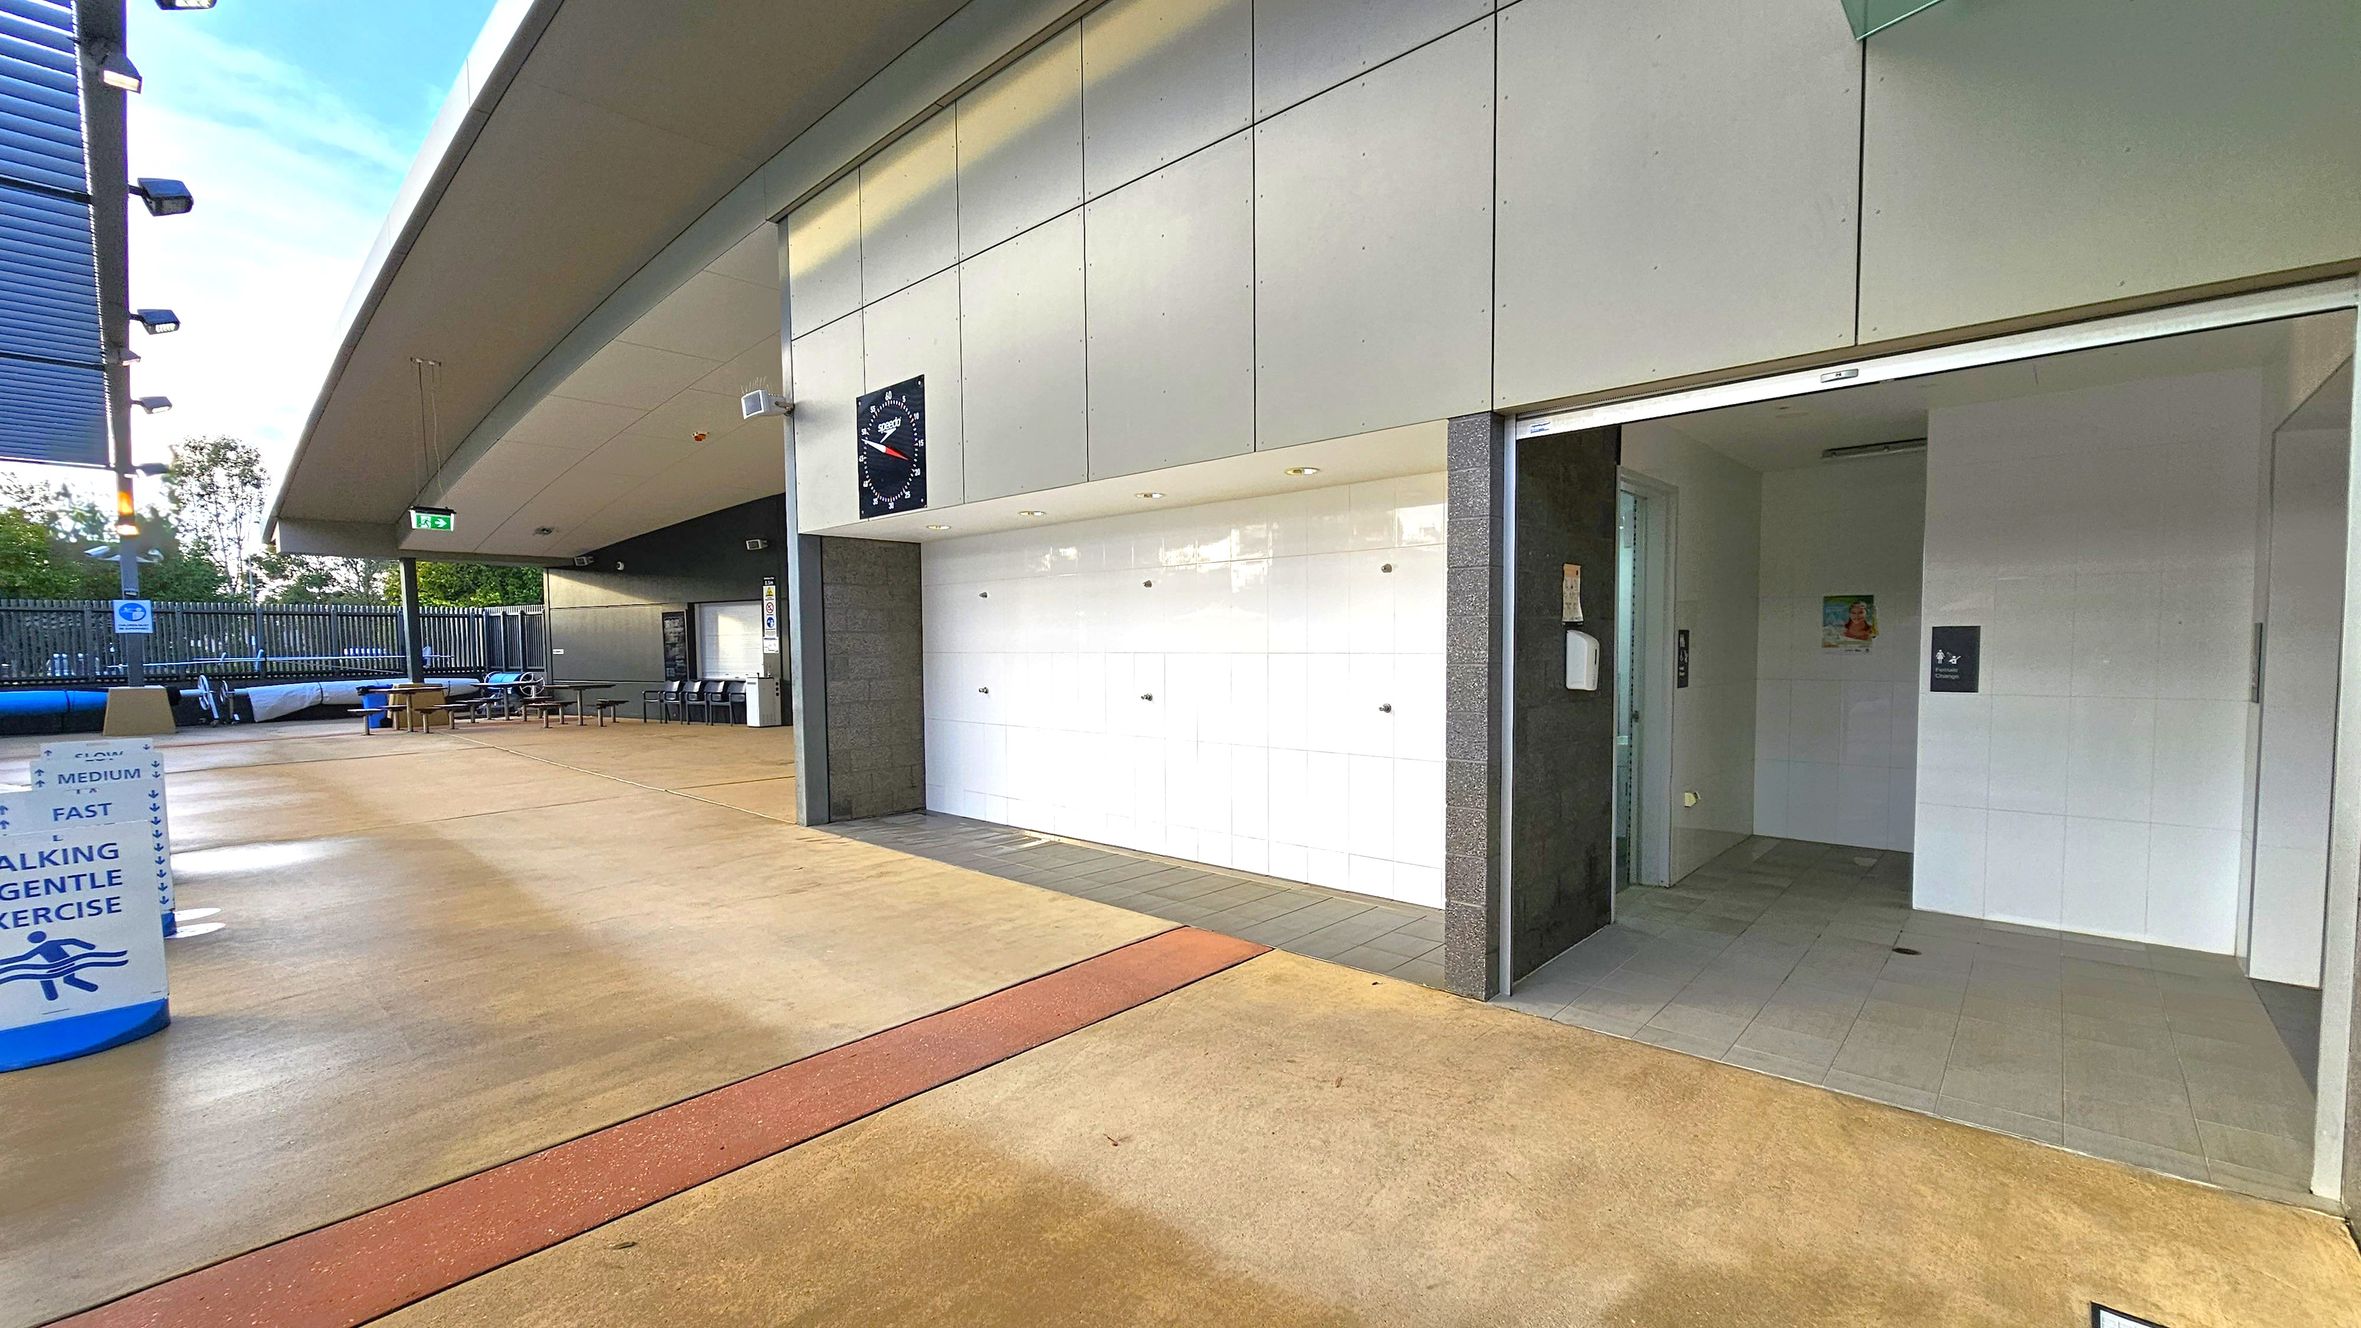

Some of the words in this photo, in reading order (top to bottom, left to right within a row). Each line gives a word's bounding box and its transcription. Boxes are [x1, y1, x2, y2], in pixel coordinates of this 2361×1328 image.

[878, 417, 901, 432] speedo
[918, 439, 924, 447] 15
[58, 768, 140, 784] MEDIUM
[52, 803, 112, 821] FAST
[0, 869, 123, 900] GENTLE
